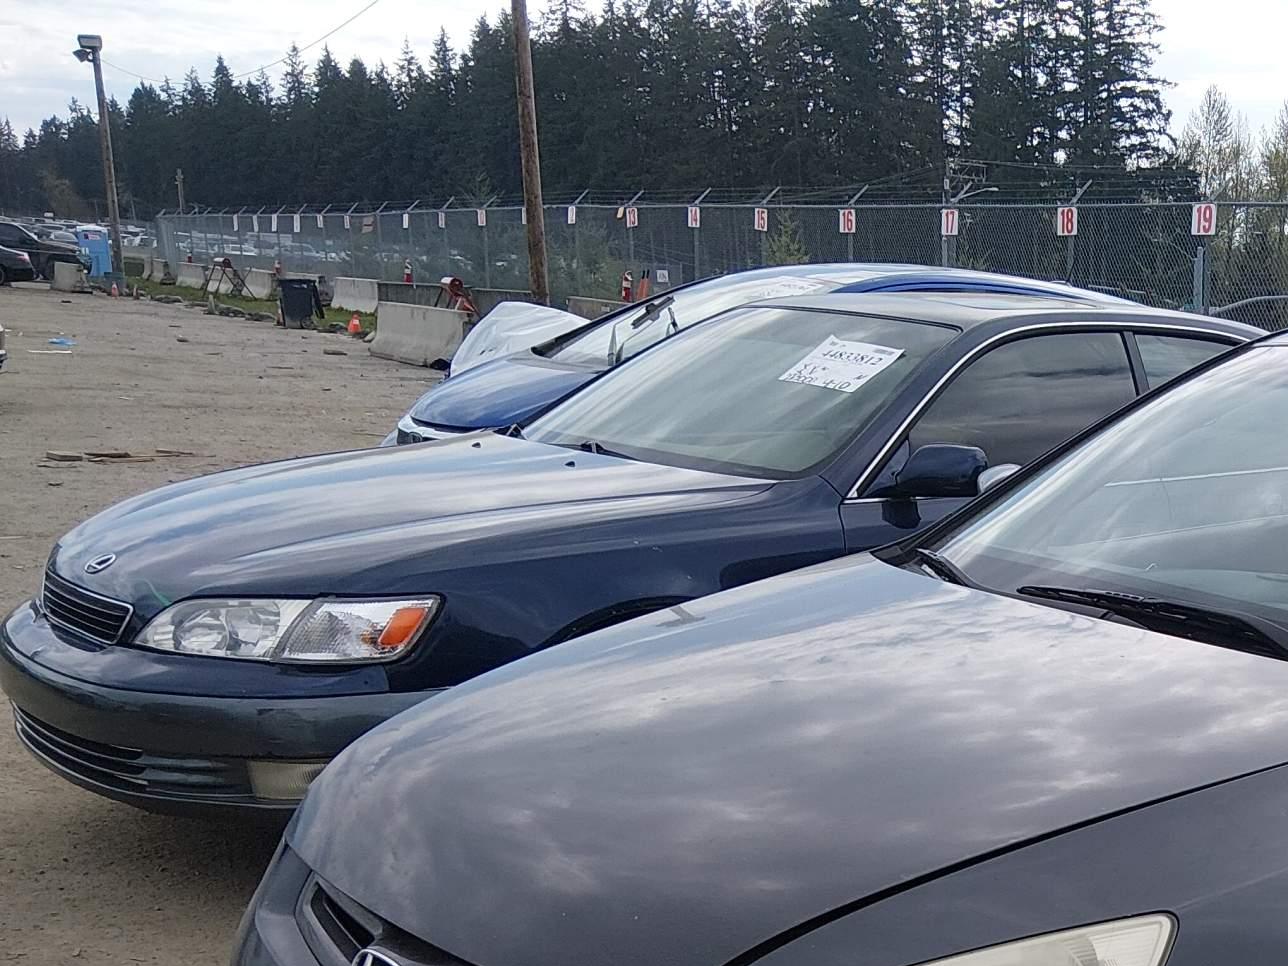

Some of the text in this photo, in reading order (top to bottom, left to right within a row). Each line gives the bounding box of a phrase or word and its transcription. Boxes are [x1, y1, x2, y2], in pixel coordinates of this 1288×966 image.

[628, 208, 636, 226] 13
[690, 208, 698, 226] 14
[757, 210, 766, 229] 15
[843, 210, 854, 232] 16
[944, 210, 956, 234] 17
[1060, 208, 1074, 234] 18
[1196, 204, 1213, 234] 19
